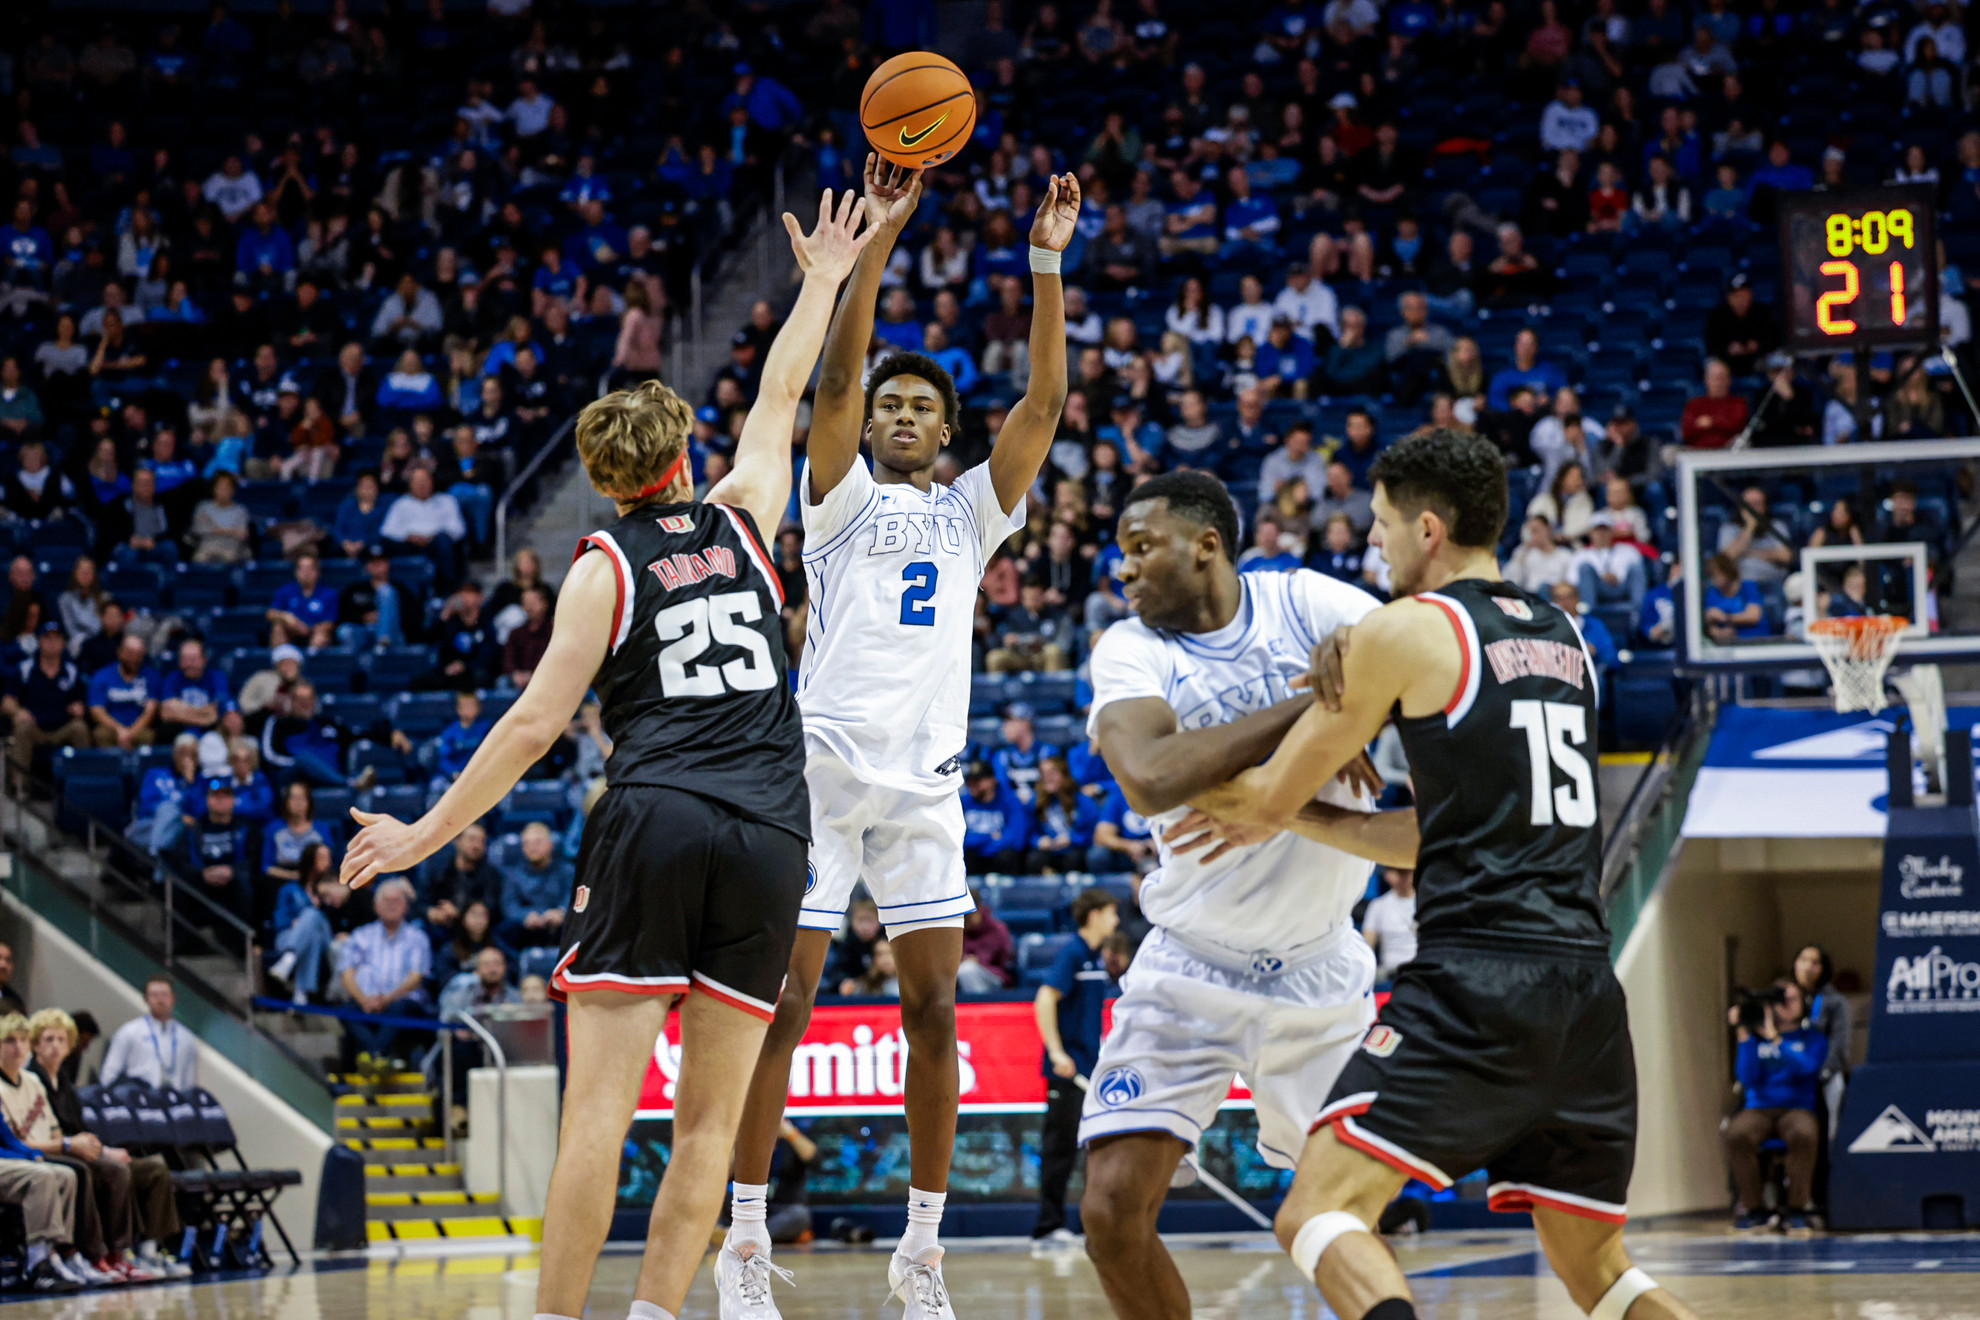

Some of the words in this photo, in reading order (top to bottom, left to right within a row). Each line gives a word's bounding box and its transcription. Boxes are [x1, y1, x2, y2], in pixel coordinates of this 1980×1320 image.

[1826, 208, 1914, 257] 8:09
[1816, 260, 1906, 335] 21
[868, 512, 965, 556] BYU
[648, 545, 736, 592] TAINAMO
[899, 562, 939, 626] 2
[655, 591, 778, 698] 25
[1509, 700, 1597, 827] 15
